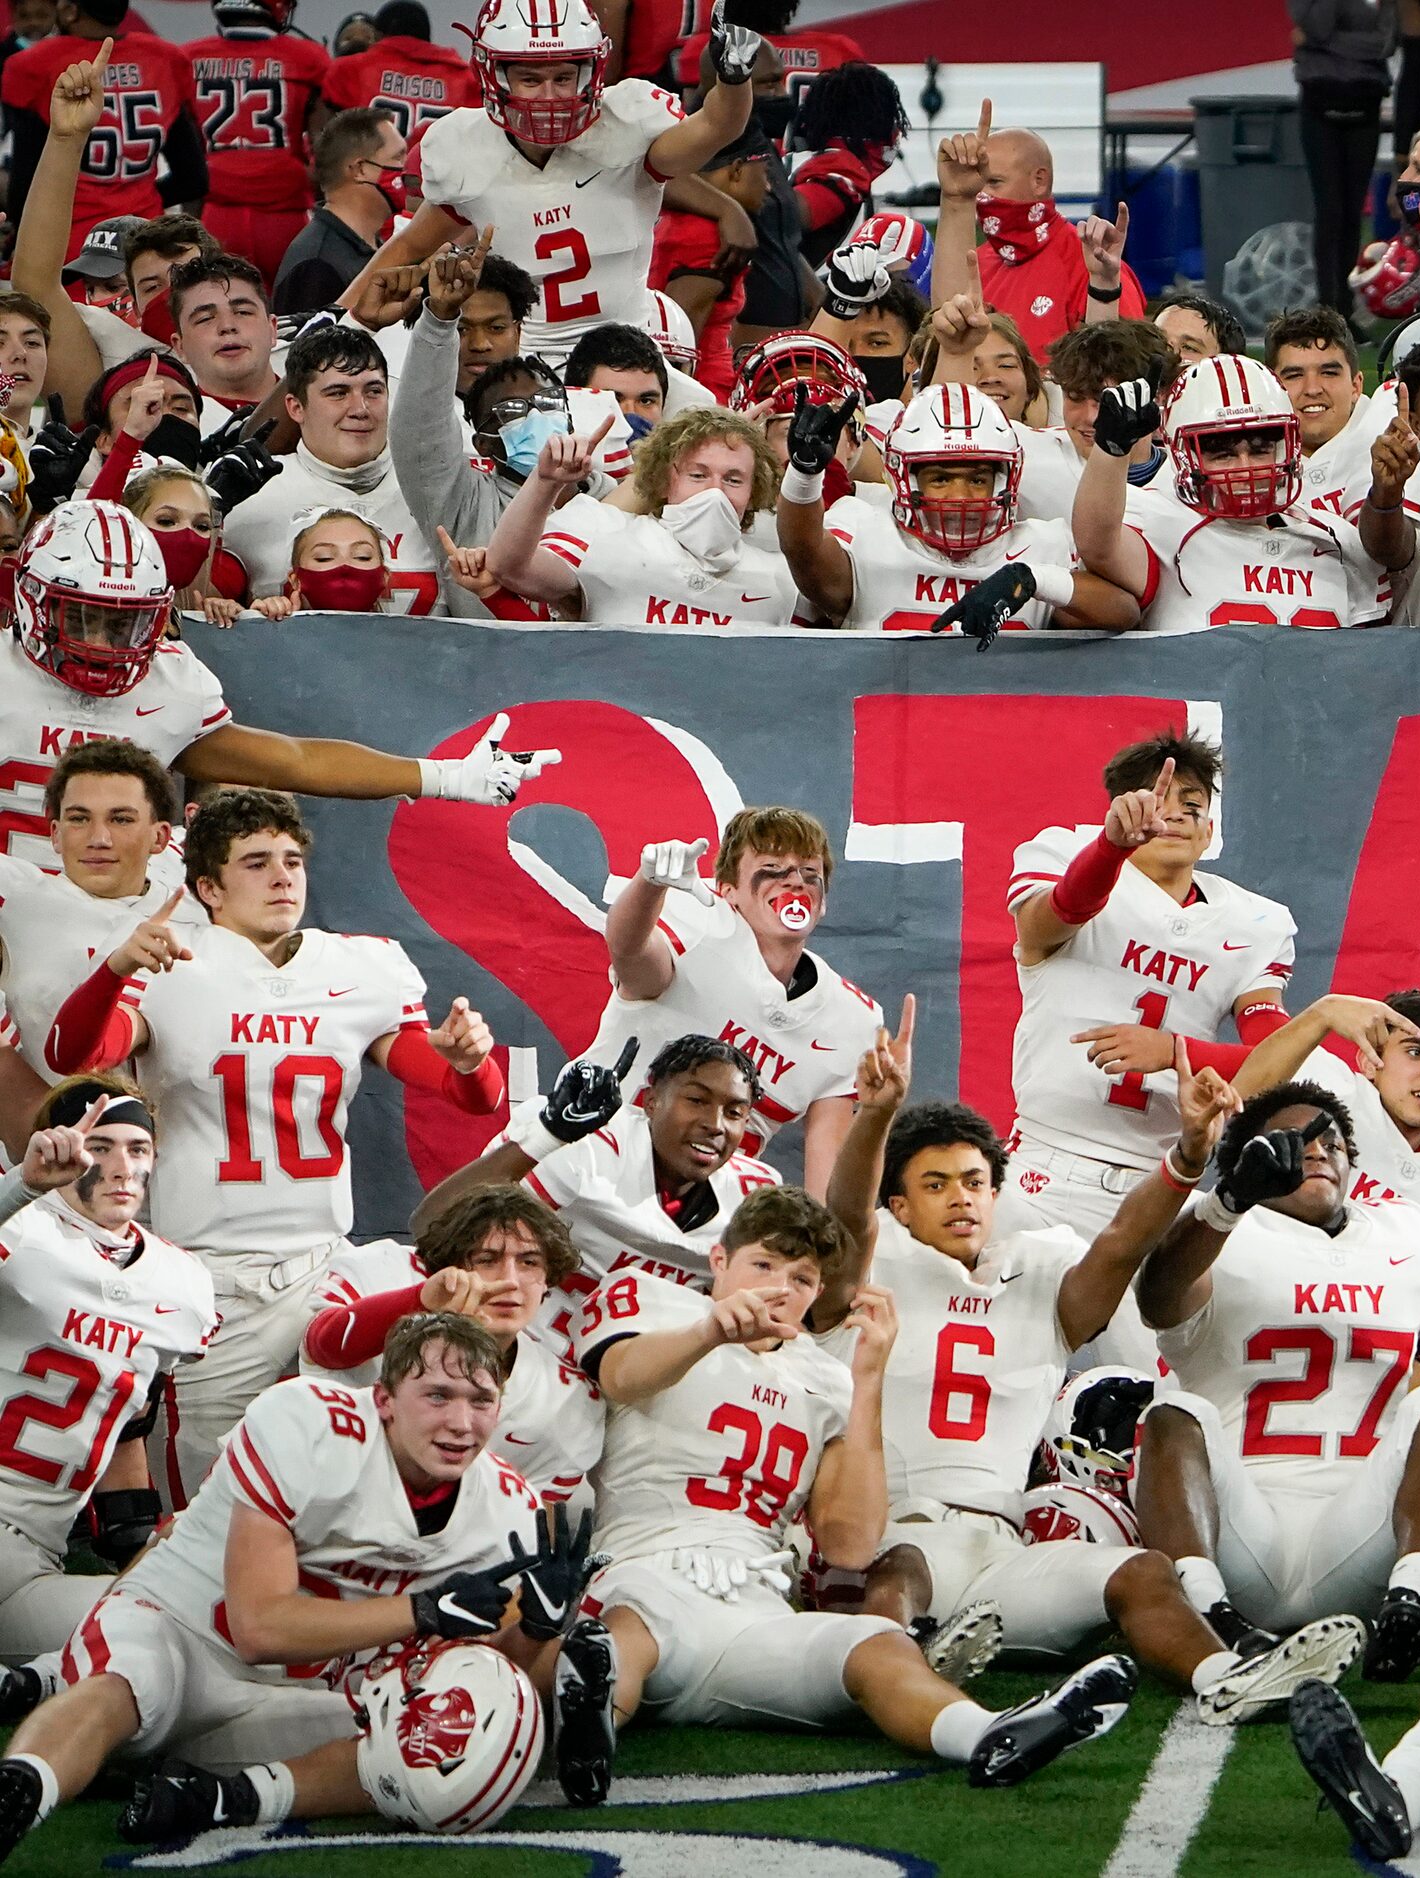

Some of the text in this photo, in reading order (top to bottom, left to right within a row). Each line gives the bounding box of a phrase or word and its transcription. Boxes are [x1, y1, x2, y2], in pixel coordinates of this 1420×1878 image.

[529, 39, 565, 48] Riddell
[778, 48, 819, 68] KINS
[193, 58, 283, 80] WILLIS JR
[379, 70, 446, 99] BRISCO
[197, 80, 291, 152] 23
[533, 204, 572, 228] KATY
[535, 227, 602, 323] 2
[1226, 406, 1254, 417] Riddell
[99, 581, 136, 591] Riddell
[915, 574, 987, 603] KAT
[1243, 565, 1313, 597] KATY
[1120, 939, 1209, 992] KATY
[231, 1013, 320, 1045] KATY
[717, 1019, 796, 1084] KATY
[1104, 987, 1172, 1116] 1
[210, 1050, 347, 1185] 10
[580, 1276, 640, 1337] 38
[947, 1295, 992, 1315] KATY
[1295, 1283, 1384, 1314] KATY
[62, 1307, 144, 1358] KATY
[752, 1384, 787, 1410] KATY
[928, 1322, 995, 1442] 6
[1240, 1324, 1418, 1460] 27
[0, 1341, 138, 1497] 21
[685, 1402, 809, 1529] 38
